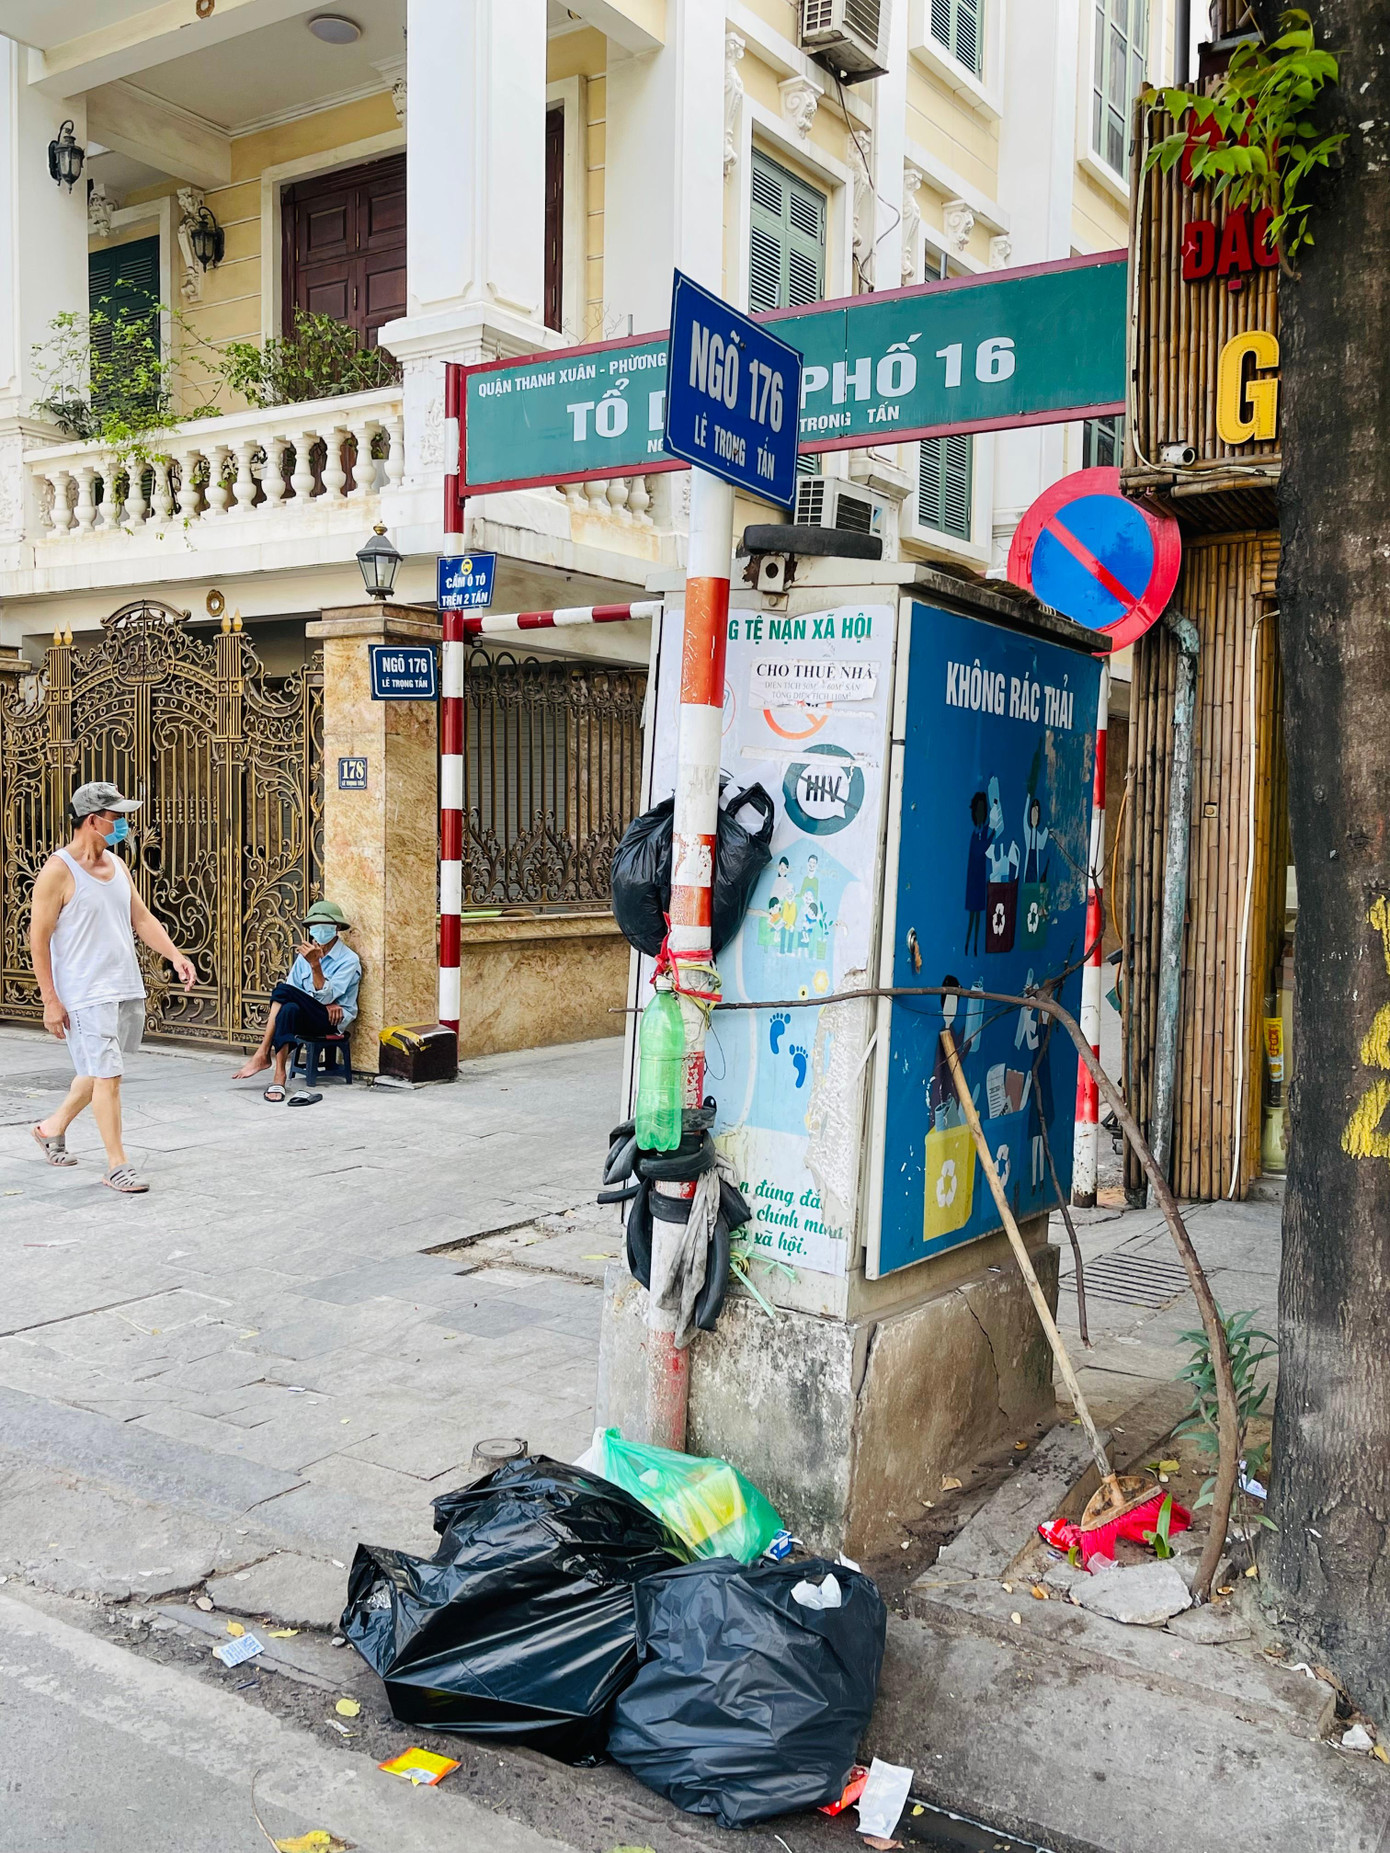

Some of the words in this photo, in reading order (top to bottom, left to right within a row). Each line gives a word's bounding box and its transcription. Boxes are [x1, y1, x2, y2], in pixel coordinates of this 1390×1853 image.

[478, 378, 512, 398] QUẬN
[514, 371, 556, 392] THANH
[558, 363, 596, 384] XUÂN
[689, 319, 740, 410] NGÕ
[749, 358, 784, 433] 176
[800, 332, 923, 410] PHỐ
[935, 336, 1016, 388] 16
[566, 377, 630, 442] TỔ
[800, 411, 851, 434] TRỌNG
[867, 401, 899, 424] TẤN
[694, 411, 708, 449] LÊ
[714, 424, 746, 467] TRỌNG
[757, 436, 775, 482] TẤN
[463, 593, 470, 604] 2
[471, 589, 488, 604] TẤN
[745, 615, 764, 645] TỆ
[768, 619, 807, 645] NẠN
[812, 613, 835, 640] XÃ
[841, 612, 872, 643] HỘI
[382, 653, 405, 673] NGÕ
[408, 657, 428, 673] 176
[756, 663, 790, 678] CHO
[793, 662, 836, 679] THUÊ
[841, 663, 873, 679] NHÀ
[945, 658, 1006, 716] KHÔNG
[1009, 671, 1041, 723] RÁC
[1044, 673, 1074, 730] THẢI
[342, 760, 365, 780] 178
[805, 775, 842, 803] HIV
[755, 1179, 795, 1207] đúng
[799, 1188, 823, 1209] đắ
[756, 1204, 799, 1229] chính
[754, 1229, 773, 1247] xã
[778, 1231, 808, 1257] hội.
